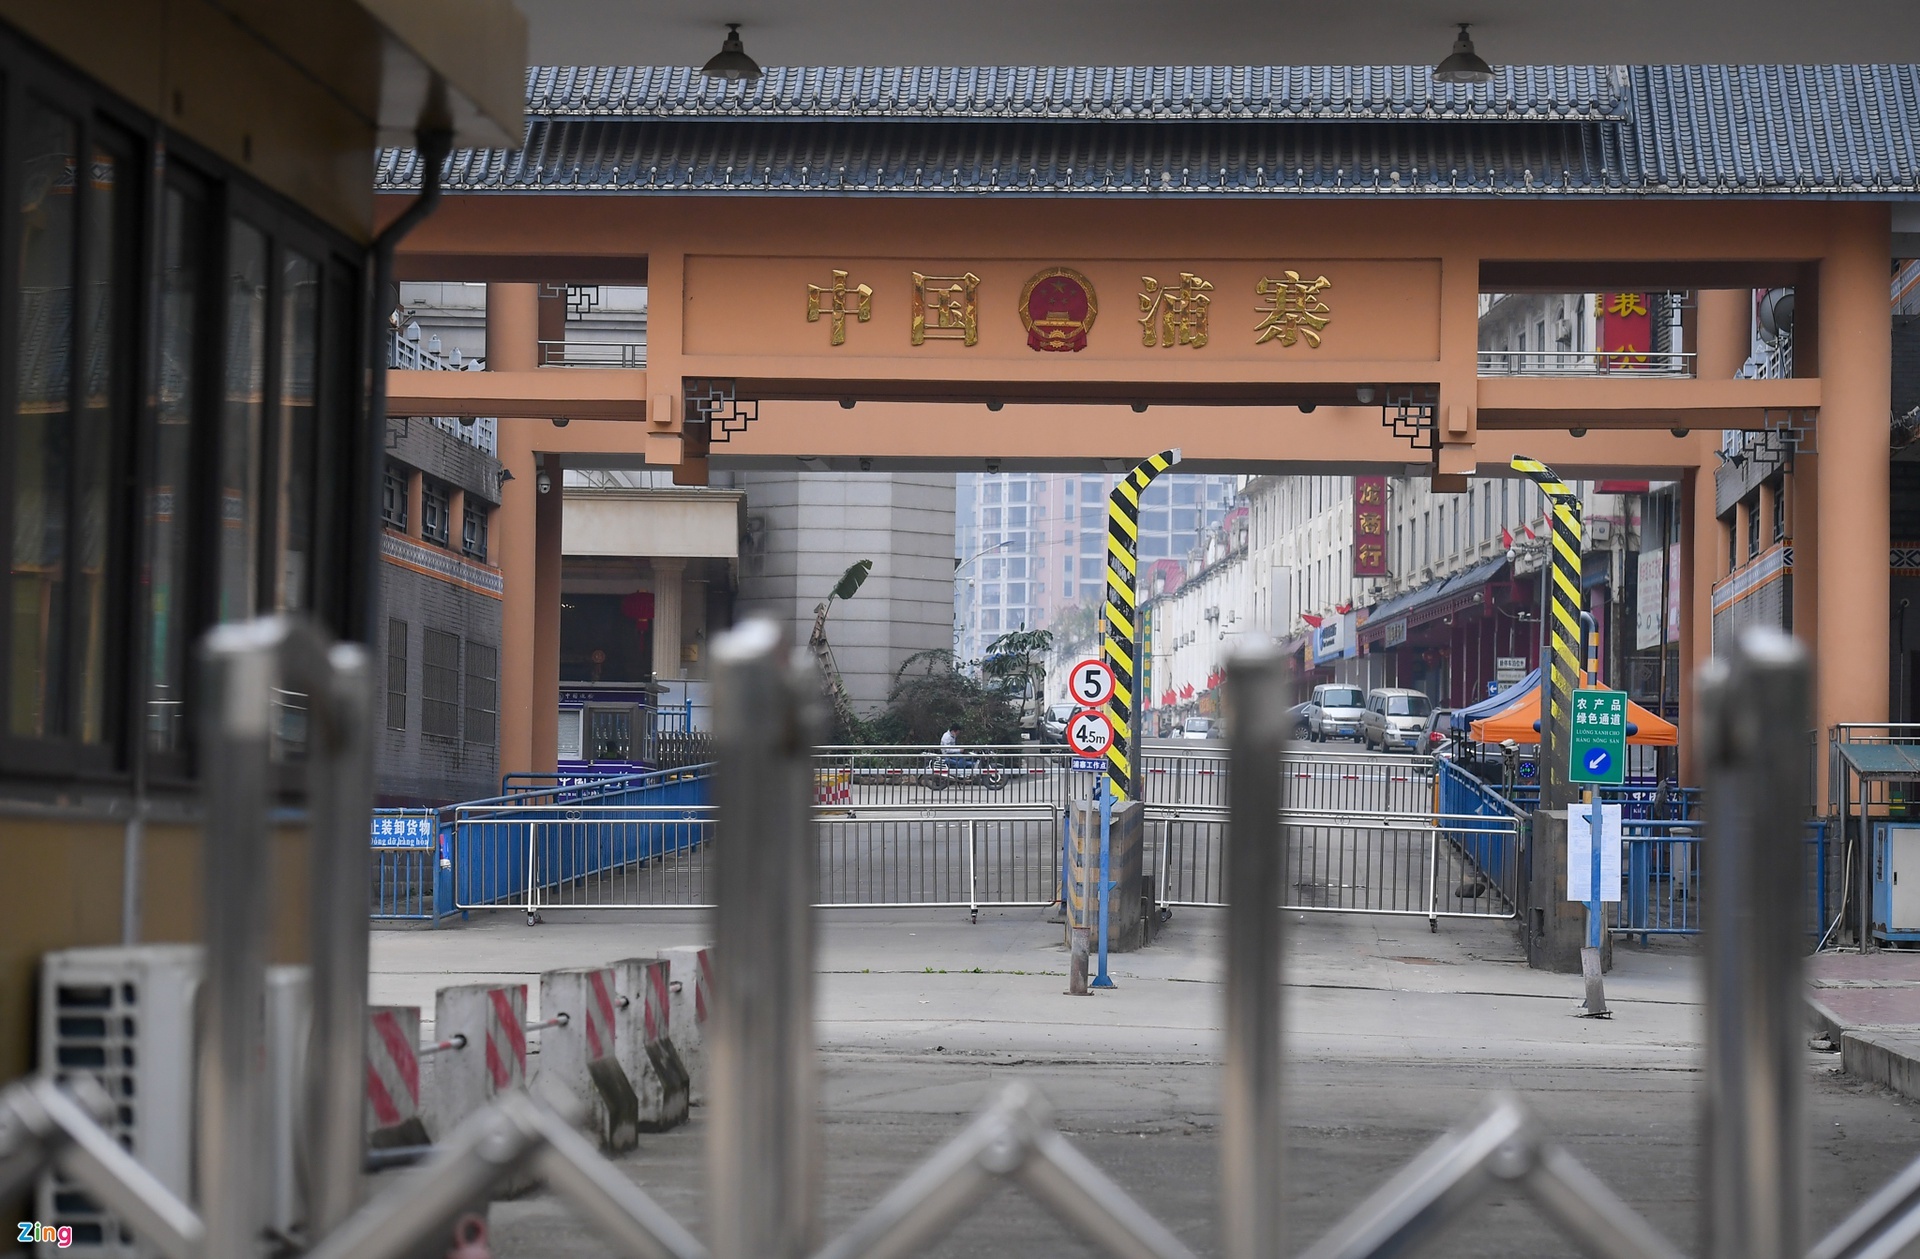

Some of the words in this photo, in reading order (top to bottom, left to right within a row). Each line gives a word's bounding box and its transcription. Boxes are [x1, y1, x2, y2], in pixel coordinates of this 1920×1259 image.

[806, 269, 981, 347] 中国
[1138, 271, 1332, 349] 浦寨
[1083, 669, 1102, 698] 5
[1576, 698, 1621, 711] 农产品
[1576, 712, 1621, 726] 绿色通道
[1076, 724, 1106, 744] 4.5m
